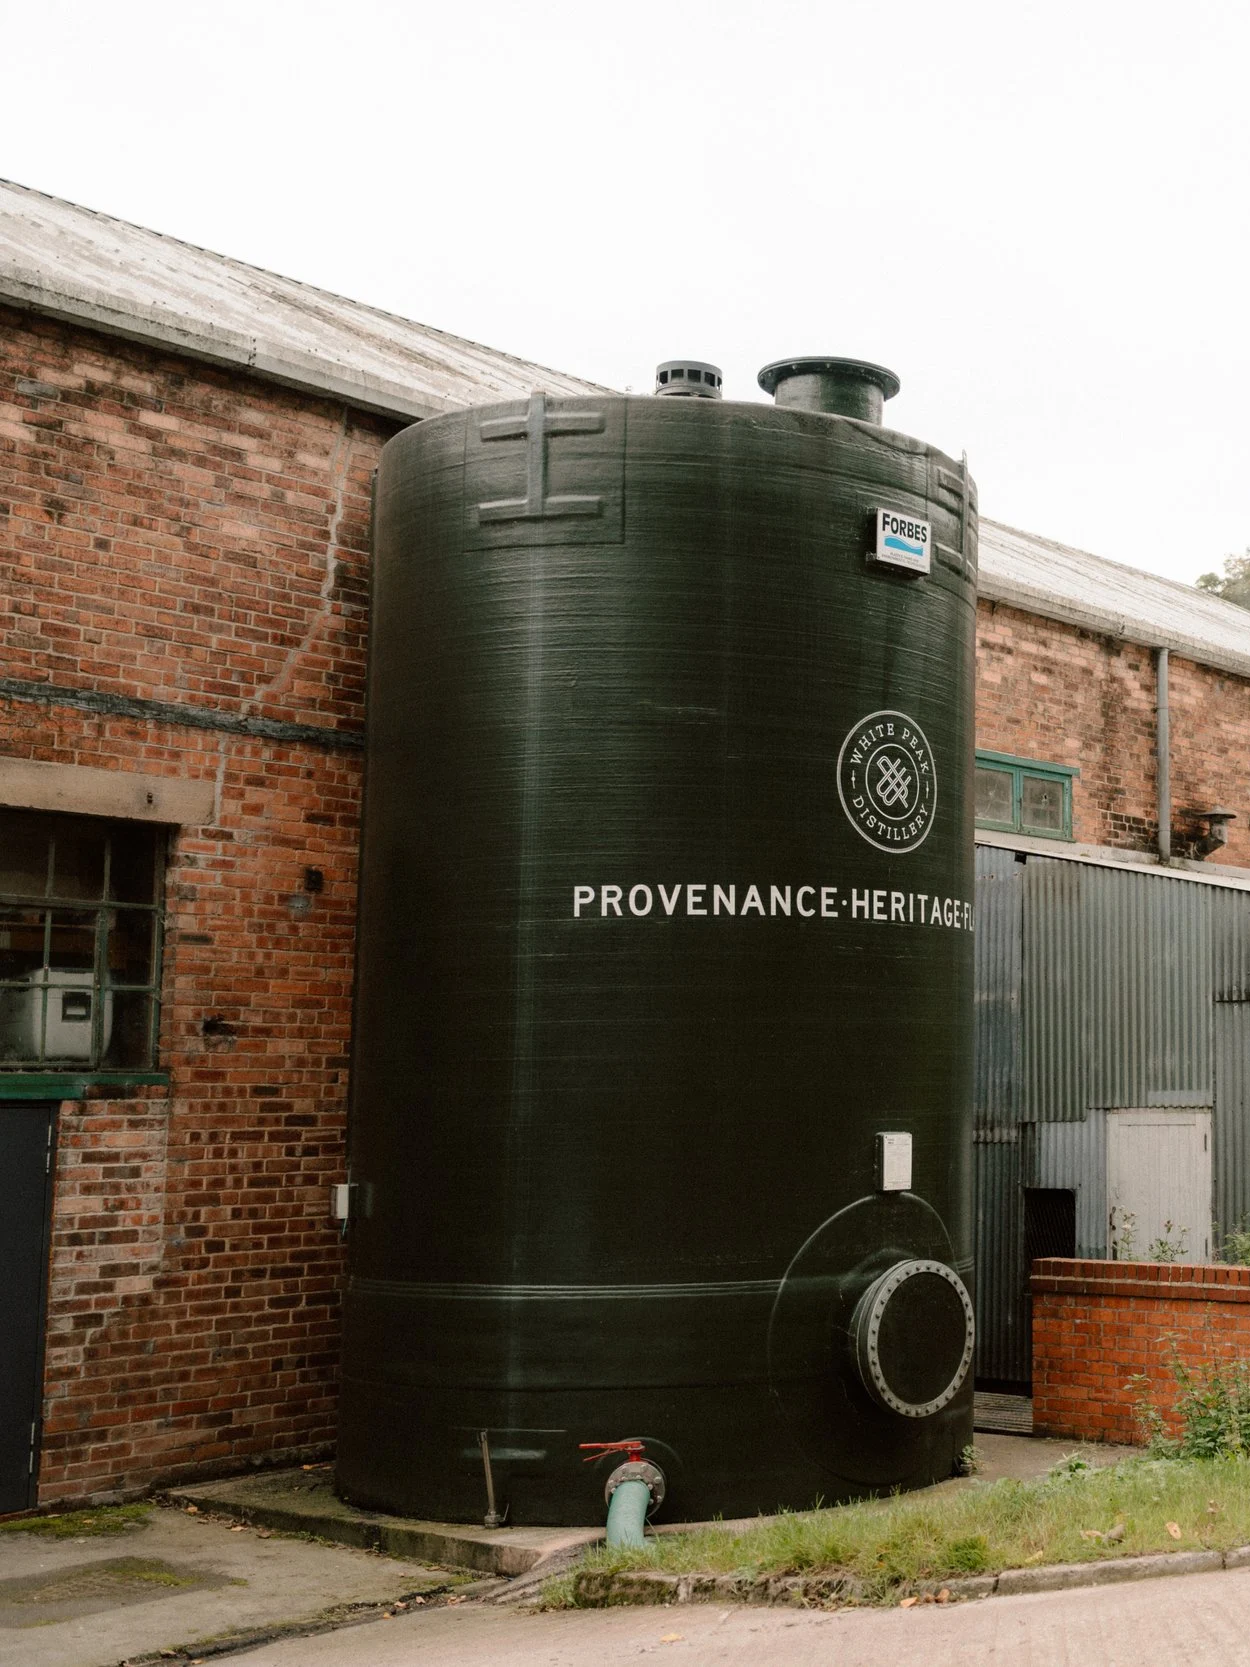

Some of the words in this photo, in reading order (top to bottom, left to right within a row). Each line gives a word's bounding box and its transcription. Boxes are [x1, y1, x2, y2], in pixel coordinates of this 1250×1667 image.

[882, 512, 927, 543] FORBES
[850, 723, 895, 765] WHITE
[902, 728, 930, 774] PEAK
[852, 795, 928, 841] DISTILLERY
[573, 884, 839, 917] PROVENANCE
[852, 888, 961, 929] HERITAGE
